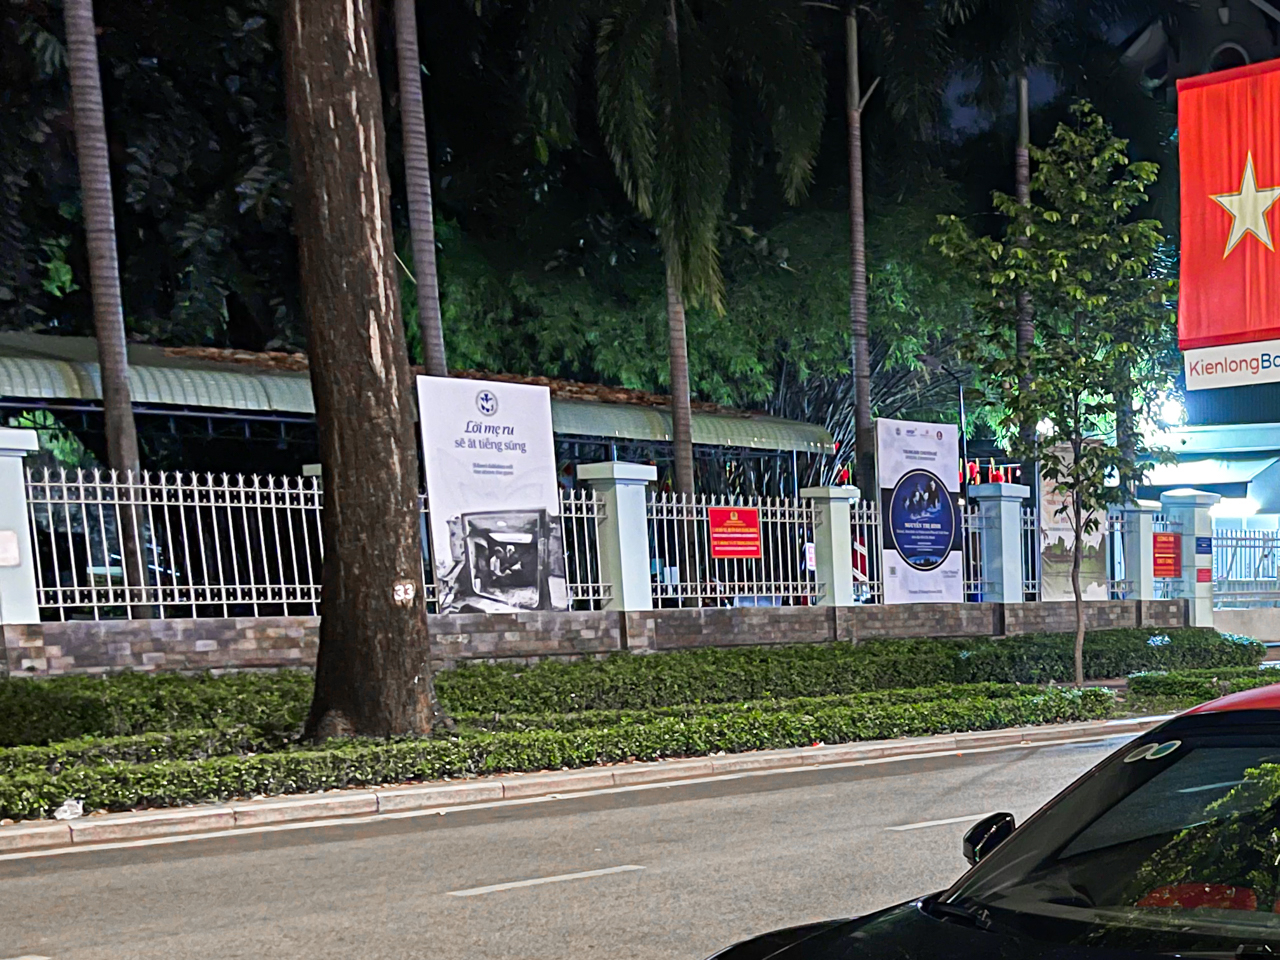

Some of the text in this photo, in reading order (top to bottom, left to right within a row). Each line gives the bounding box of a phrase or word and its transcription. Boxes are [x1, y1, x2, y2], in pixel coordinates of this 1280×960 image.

[464, 420, 515, 437] Lời mẹ ru
[455, 437, 466, 448] sẽ
[478, 437, 504, 453] tiếng
[503, 440, 527, 454] súng
[394, 584, 414, 600] 33
